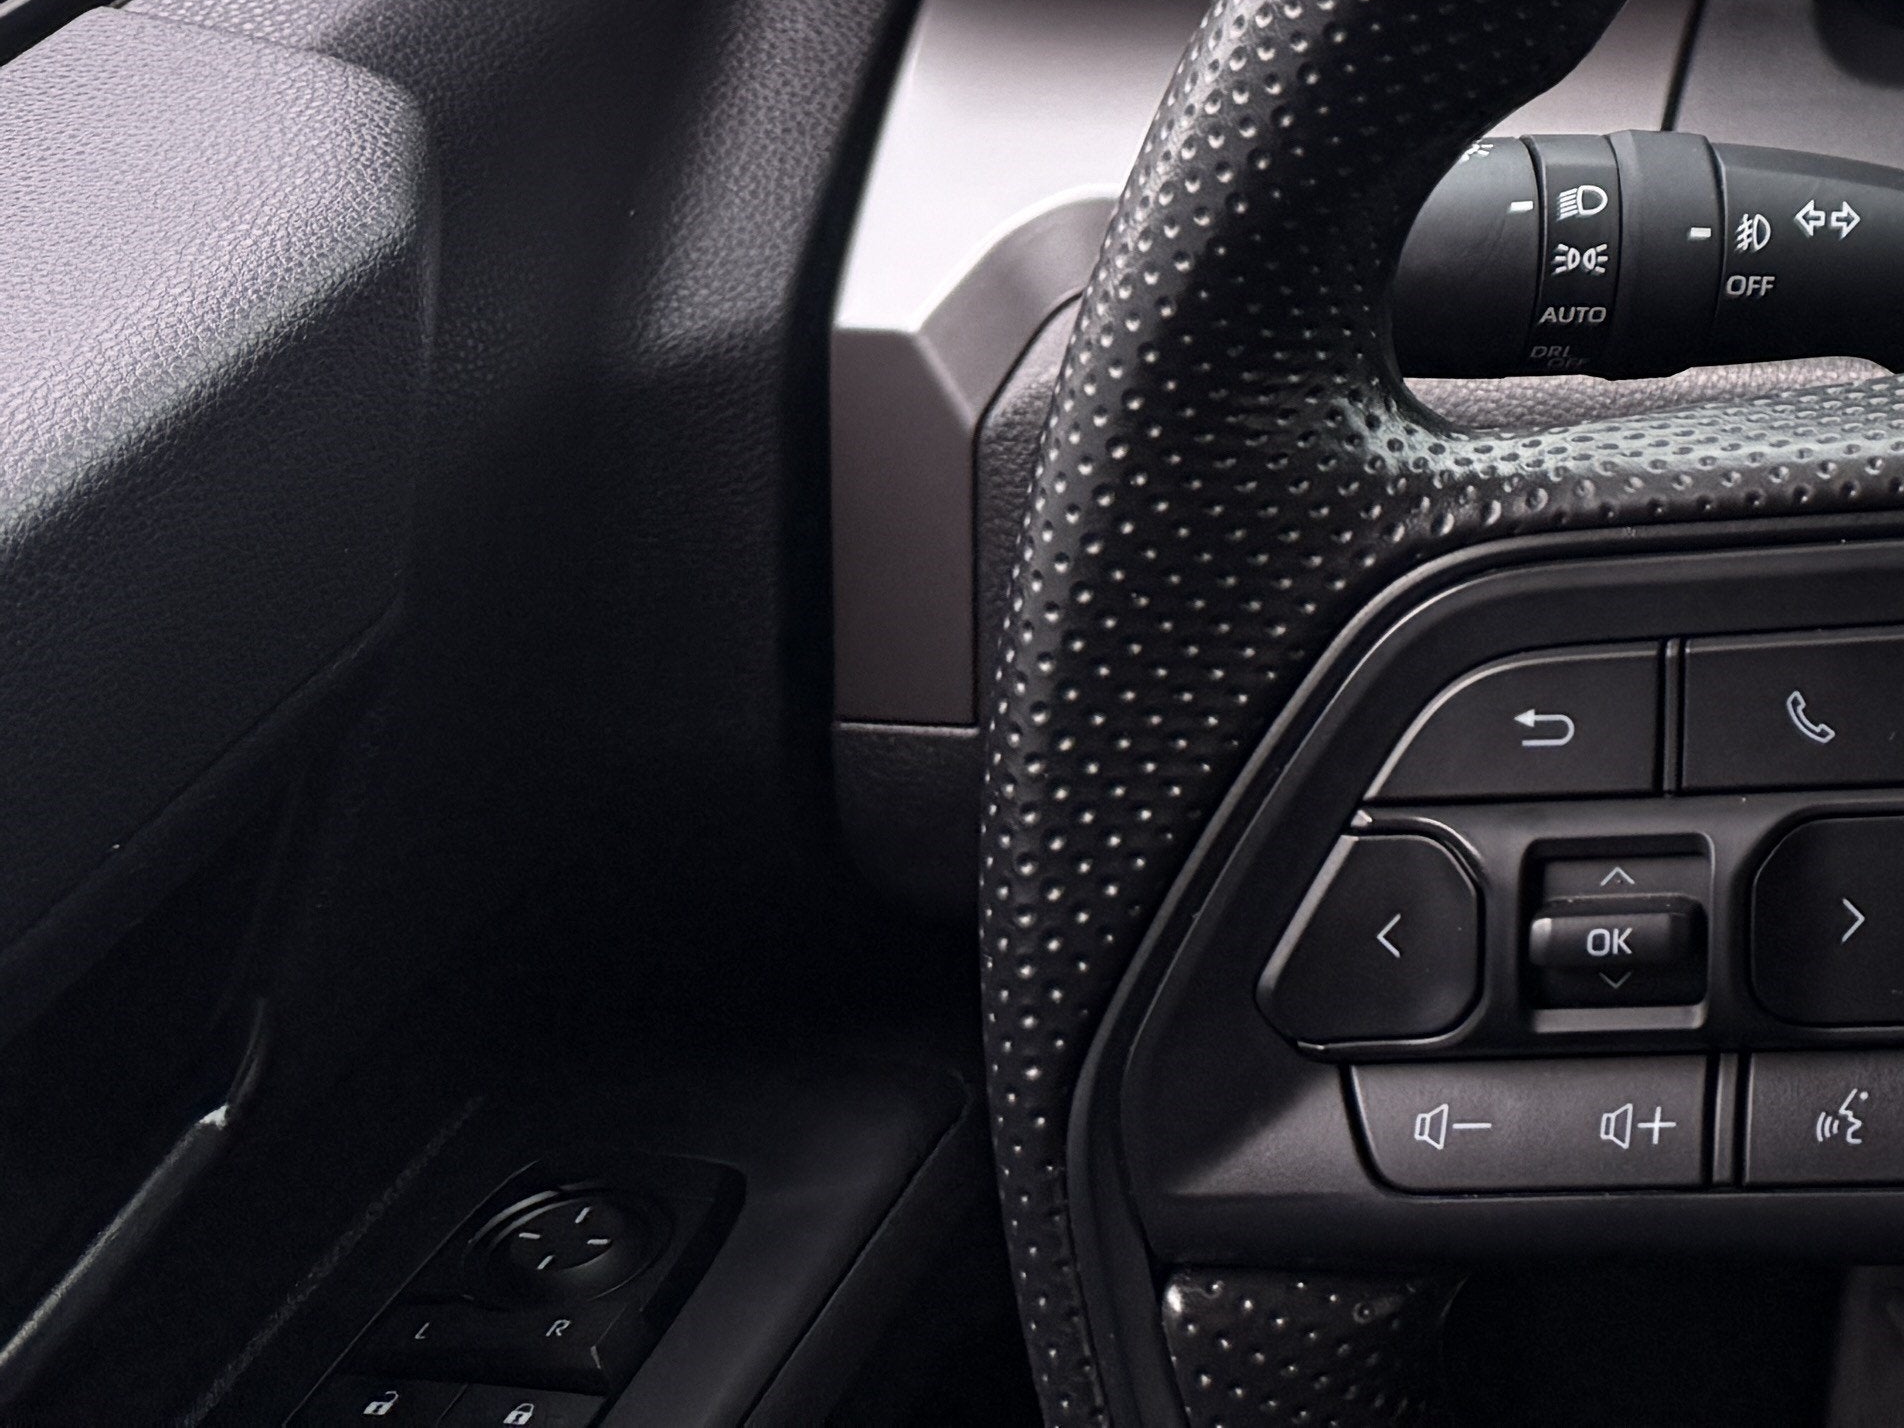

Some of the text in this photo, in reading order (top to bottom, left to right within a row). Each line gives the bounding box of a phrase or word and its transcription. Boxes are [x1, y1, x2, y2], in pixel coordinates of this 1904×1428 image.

[1724, 274, 1776, 297] OFF
[1537, 305, 1608, 325] AUTO
[1586, 927, 1633, 957] OK
[414, 1319, 571, 1340] L R
